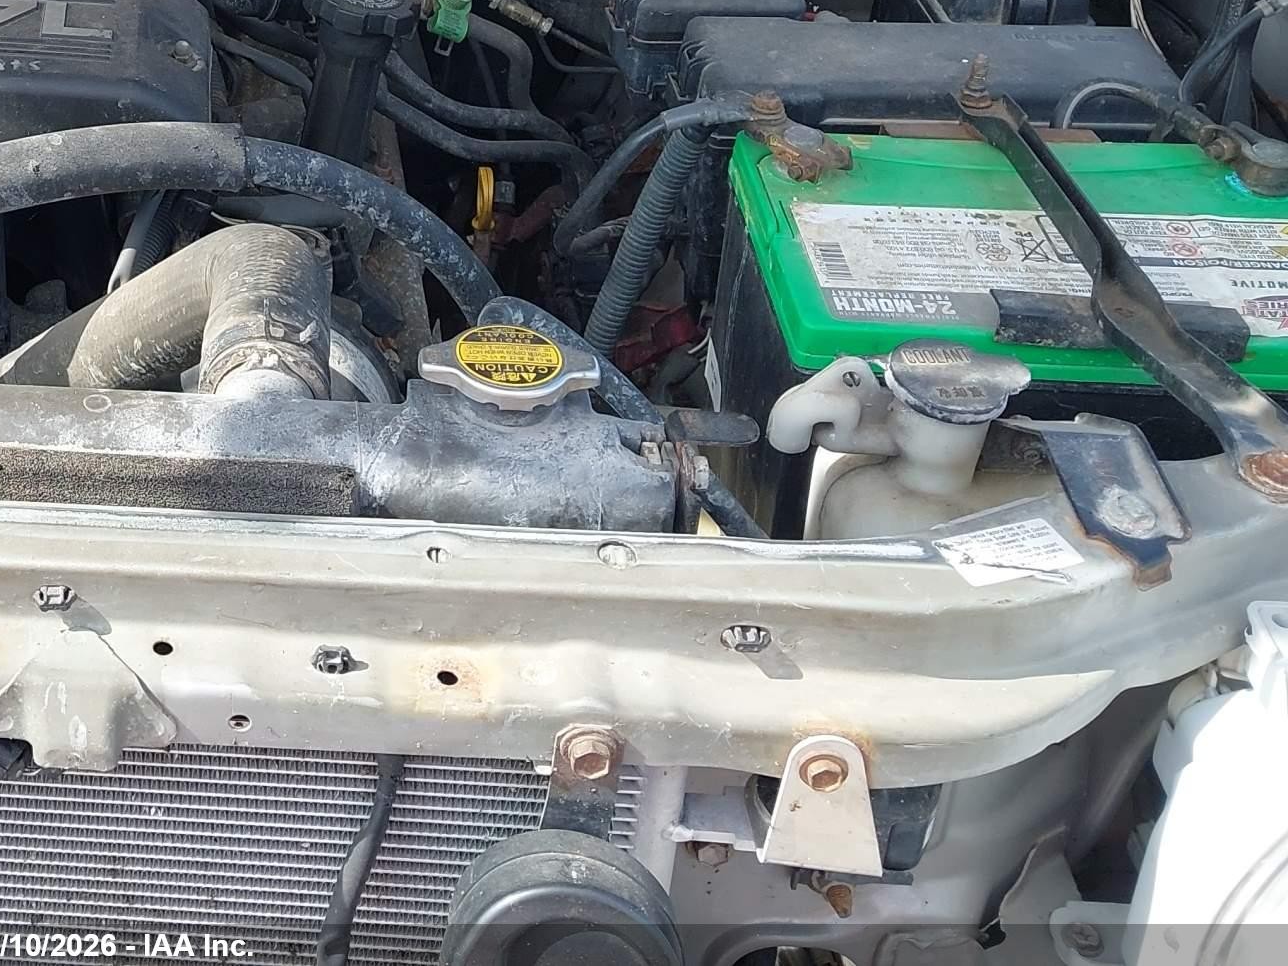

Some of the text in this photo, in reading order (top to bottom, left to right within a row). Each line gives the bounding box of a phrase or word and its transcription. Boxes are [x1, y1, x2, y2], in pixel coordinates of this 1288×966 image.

[1173, 259, 1288, 268] DANGER/POISON
[1231, 279, 1288, 288] MOTIVE
[831, 289, 950, 301] FREE REPLACEMENT
[833, 296, 957, 315] 24-MONTH
[477, 331, 534, 339] COOLANT
[902, 347, 971, 365] COOLANT
[475, 364, 549, 374] CAUTION
